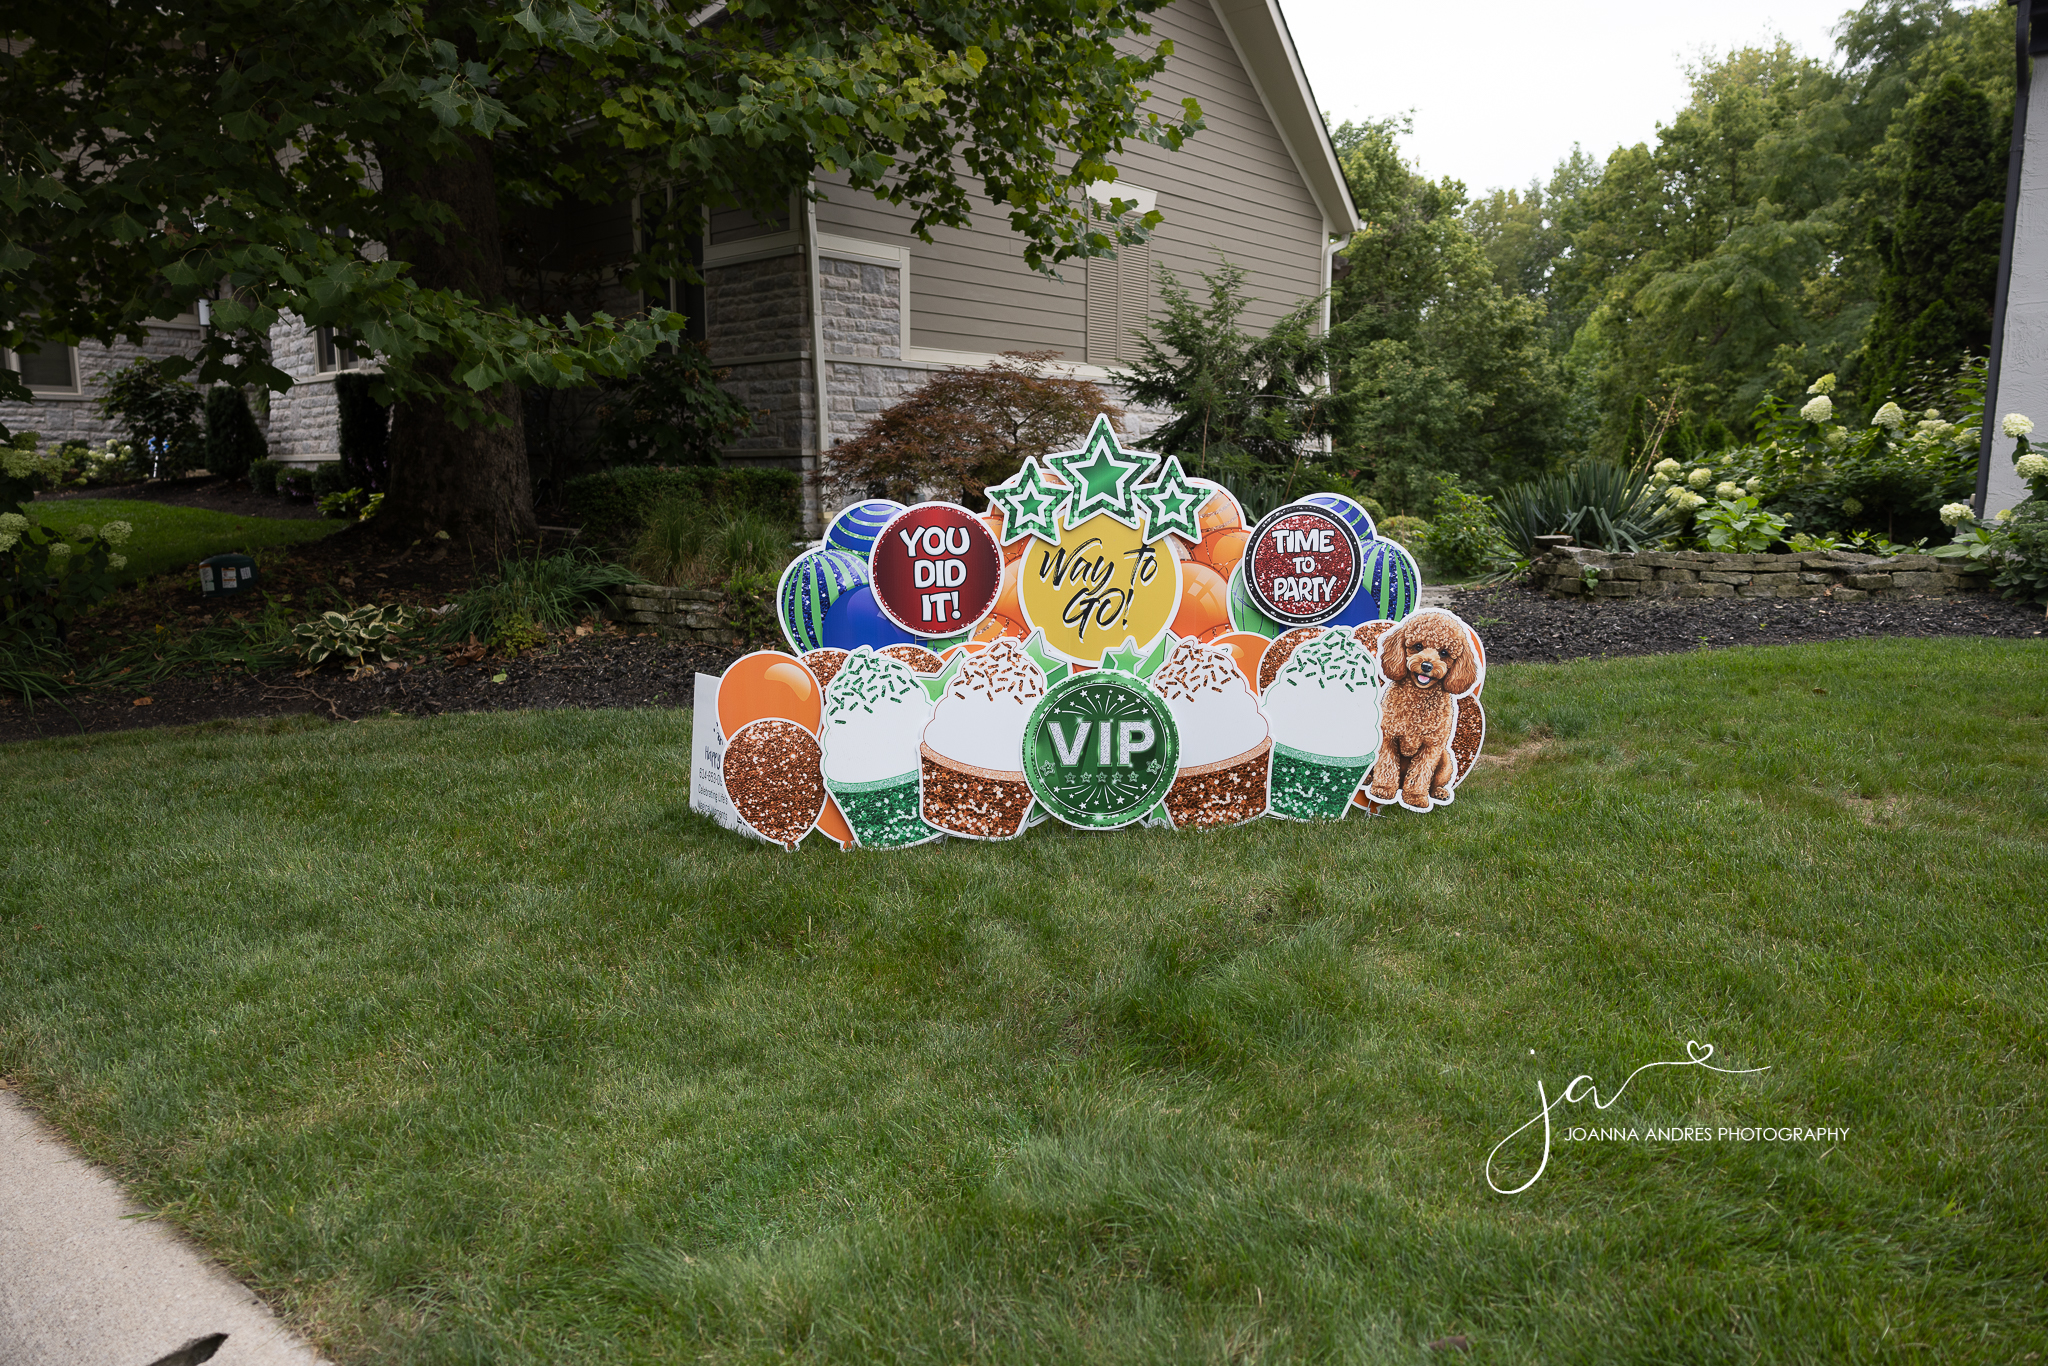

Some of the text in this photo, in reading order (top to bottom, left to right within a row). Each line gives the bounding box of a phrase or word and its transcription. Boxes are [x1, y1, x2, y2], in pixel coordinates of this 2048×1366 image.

[899, 525, 971, 558] YOU
[1271, 528, 1335, 554] TIME
[913, 558, 967, 589] DID
[1039, 538, 1114, 596] Way
[1292, 556, 1316, 574] TO
[1273, 575, 1338, 602] PARTY
[921, 590, 962, 622] IT!
[1062, 587, 1135, 641] GO!
[1046, 720, 1155, 768] VIP
